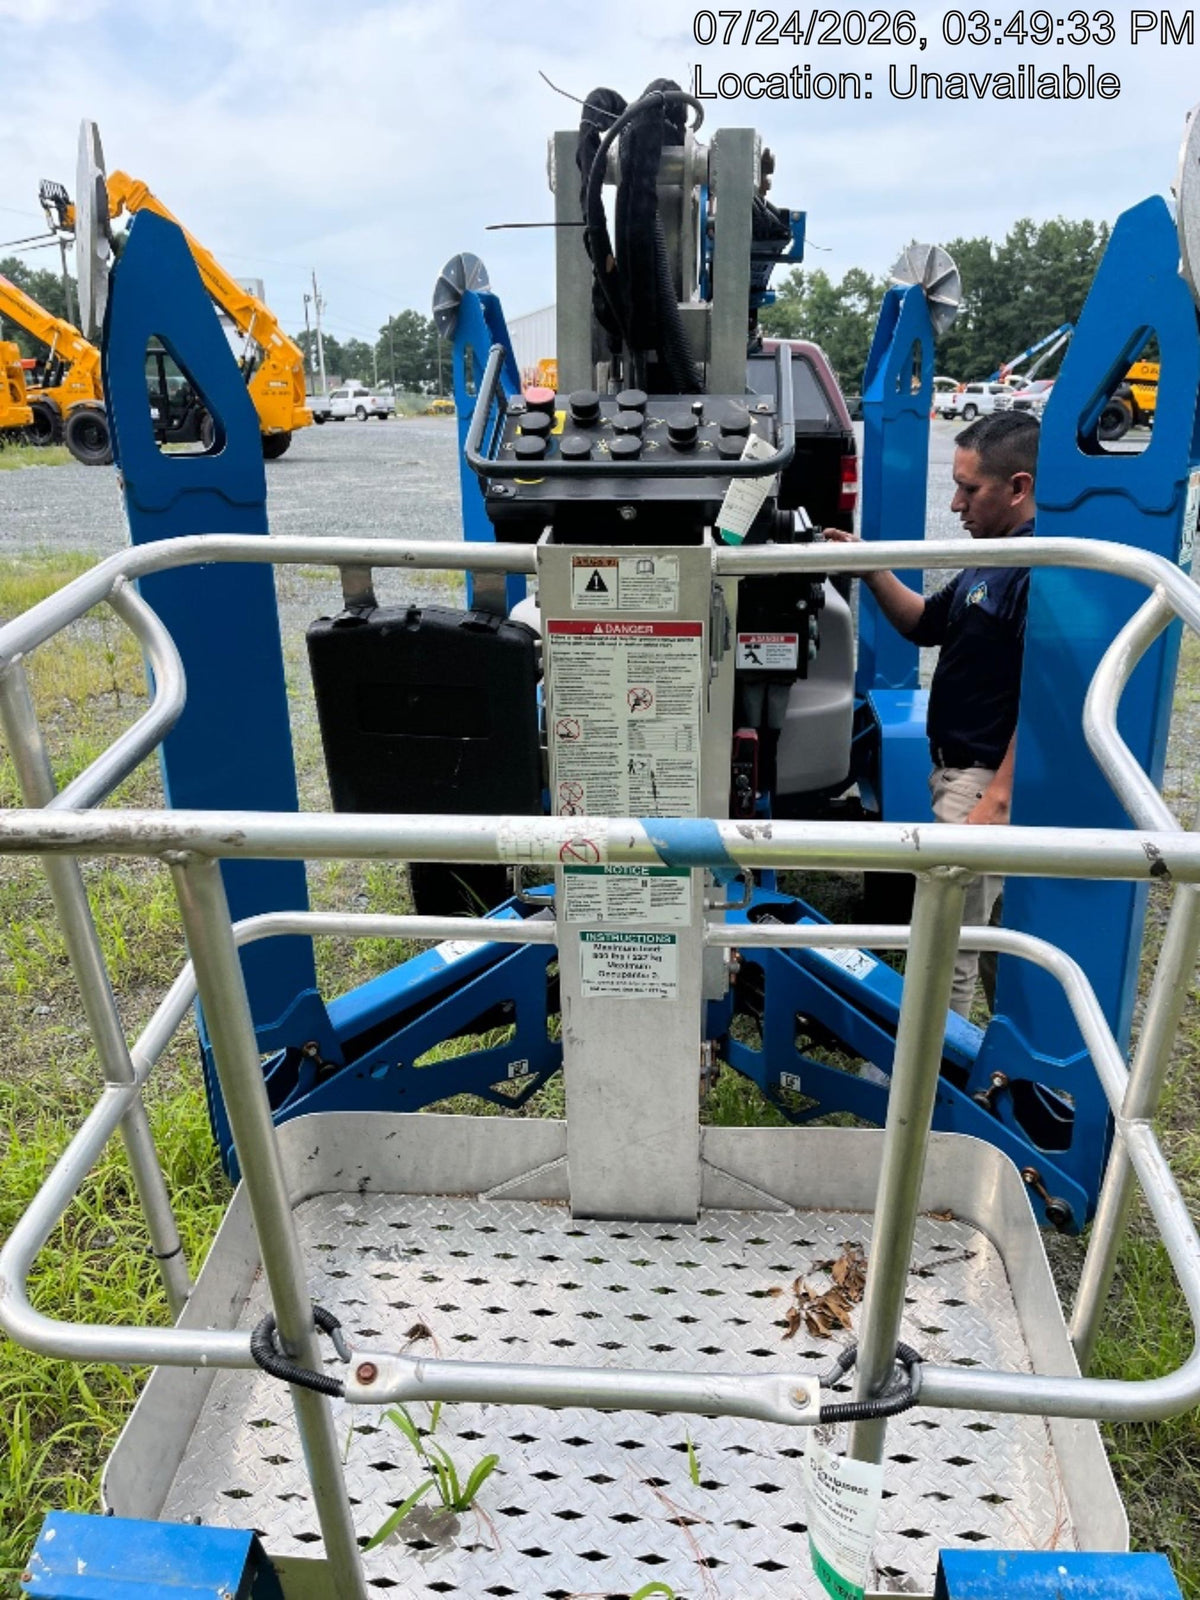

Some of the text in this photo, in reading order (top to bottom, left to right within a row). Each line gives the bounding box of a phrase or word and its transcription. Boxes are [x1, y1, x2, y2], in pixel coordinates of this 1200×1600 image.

[605, 623, 654, 635] DANGER
[603, 864, 650, 876] NOTICE
[585, 932, 671, 944] INSTRUCTIONS
